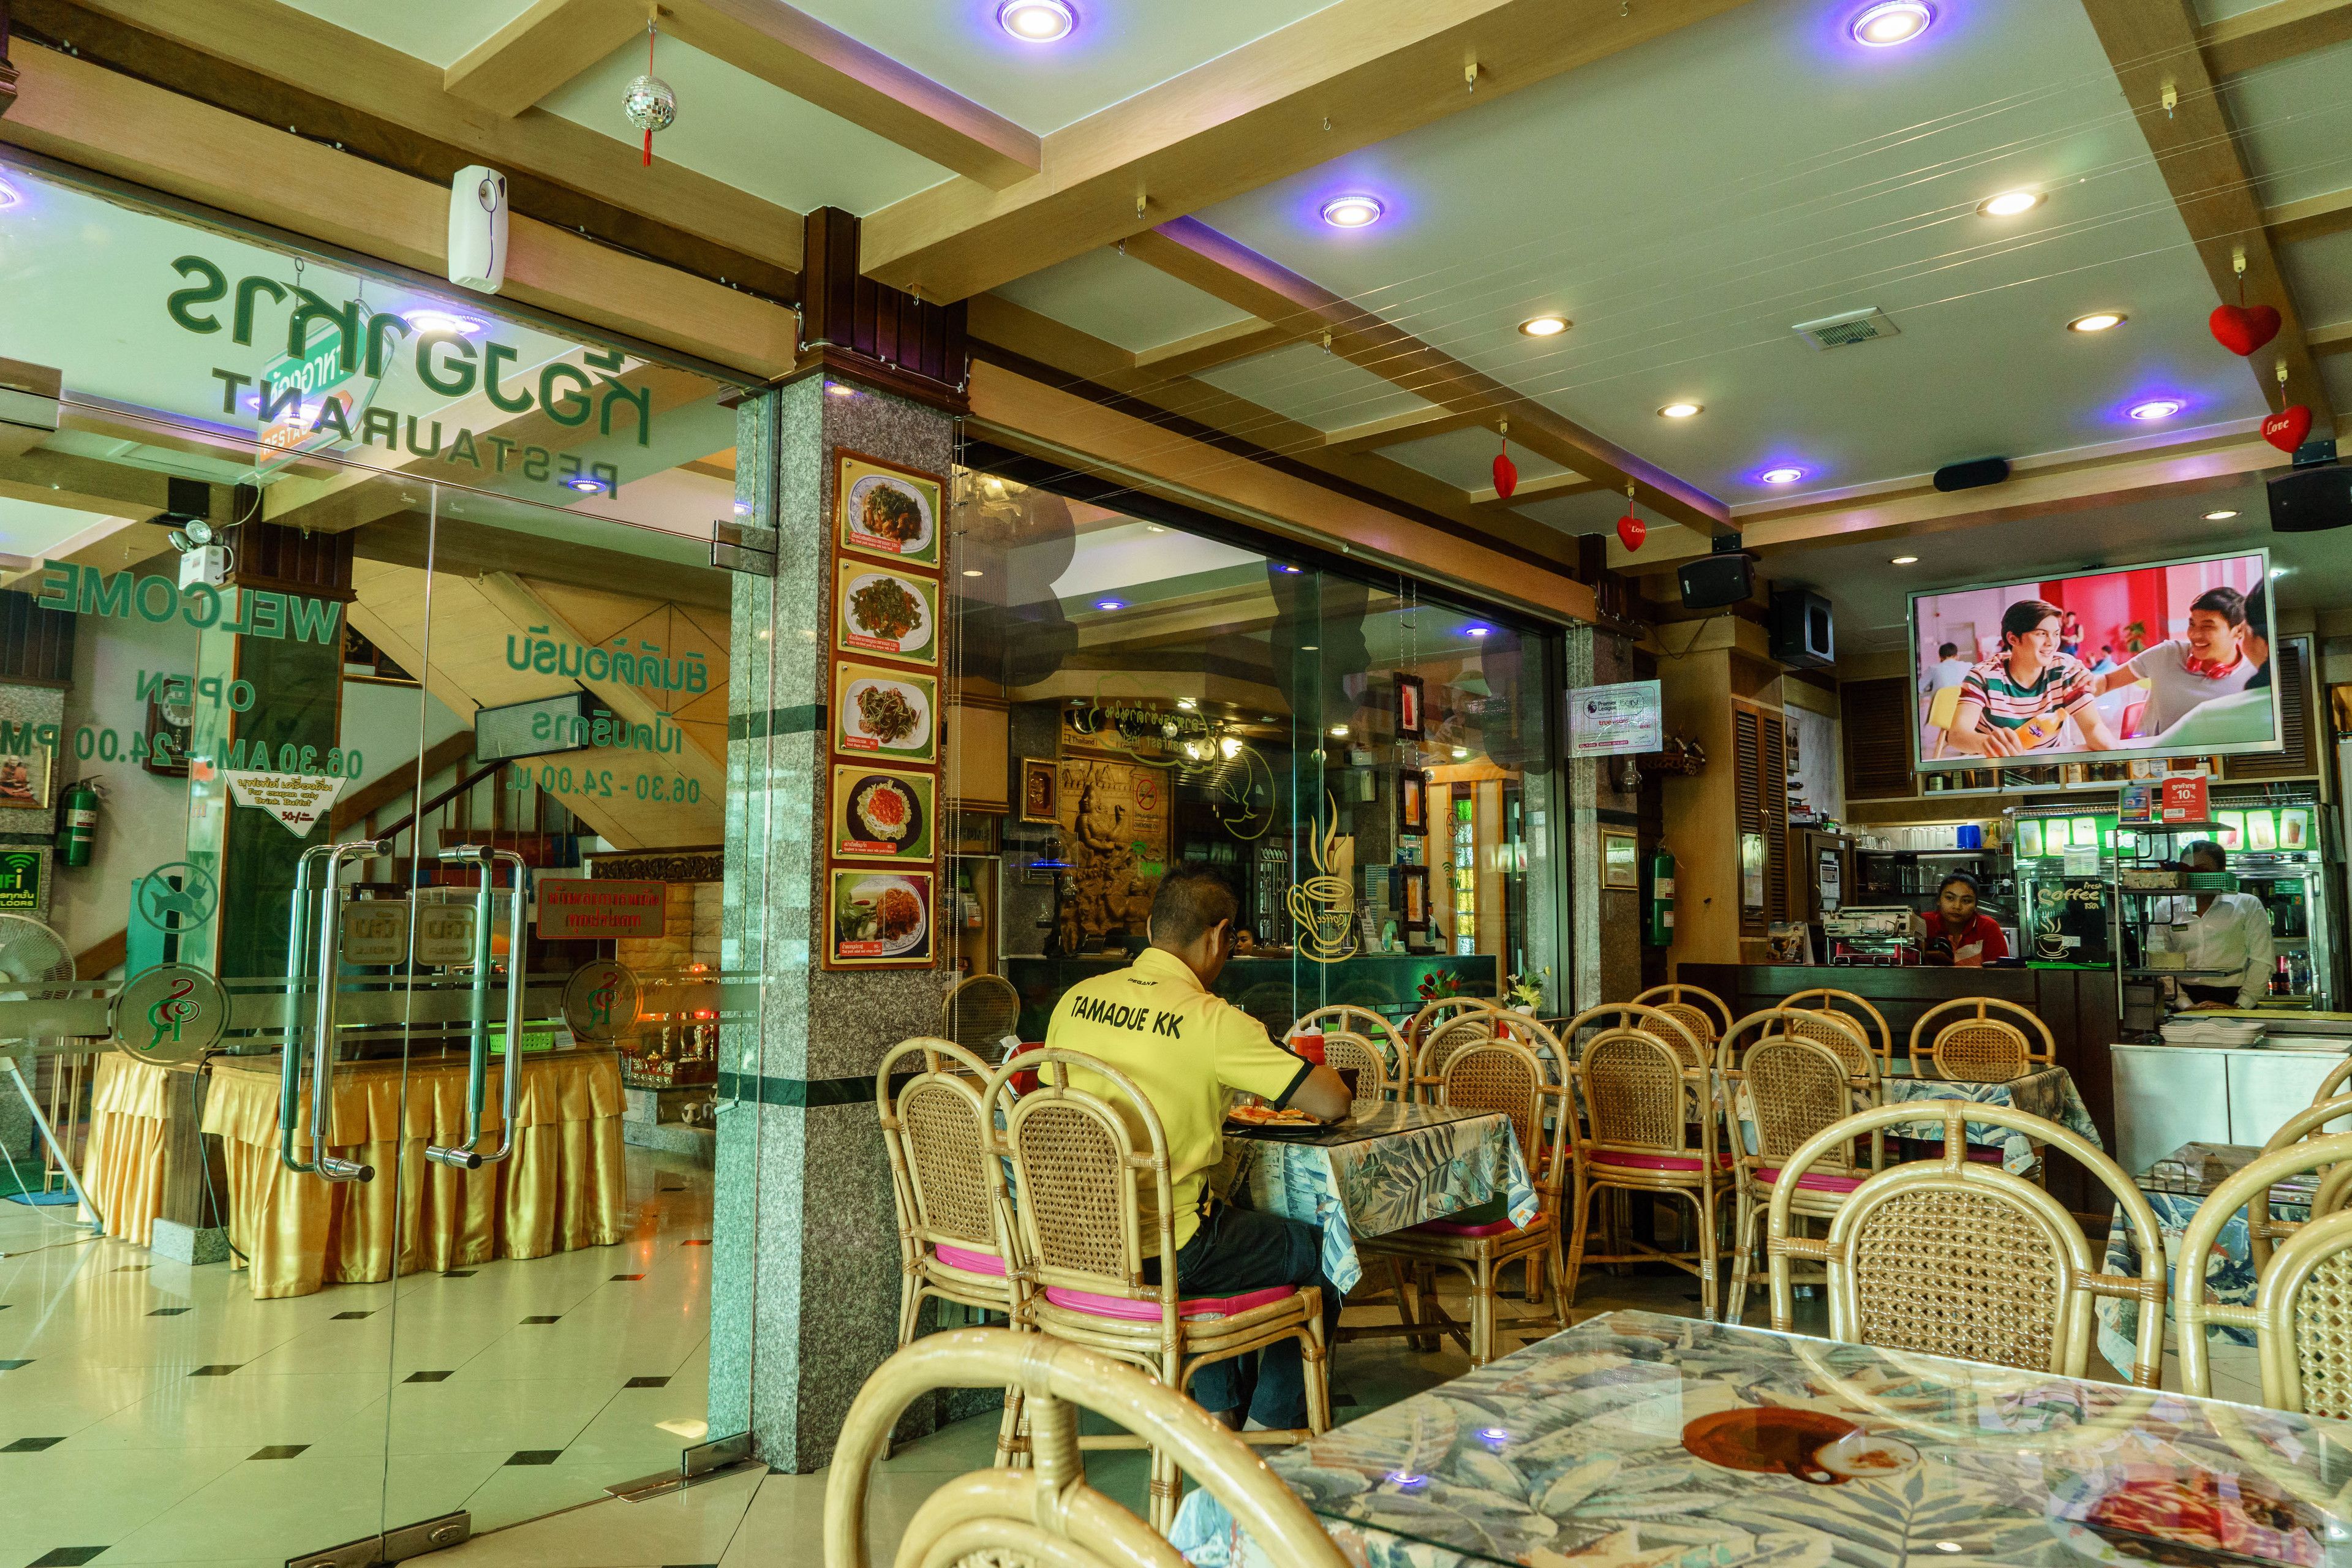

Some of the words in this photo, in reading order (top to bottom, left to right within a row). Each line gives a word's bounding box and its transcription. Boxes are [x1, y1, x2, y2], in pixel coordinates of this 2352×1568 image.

[2266, 419, 2290, 435] Love
[1072, 736, 1095, 745] Thailand
[281, 776, 333, 791] เครื่องดื่ม
[255, 796, 280, 805] Drink
[284, 798, 312, 807] Buffet
[301, 791, 319, 800] only
[0, 868, 23, 889] IFi
[2038, 888, 2100, 907] Coffee
[1127, 978, 1152, 986] PEGAN
[1071, 995, 1149, 1031] TAMADUE
[1152, 1011, 1183, 1039] KK
